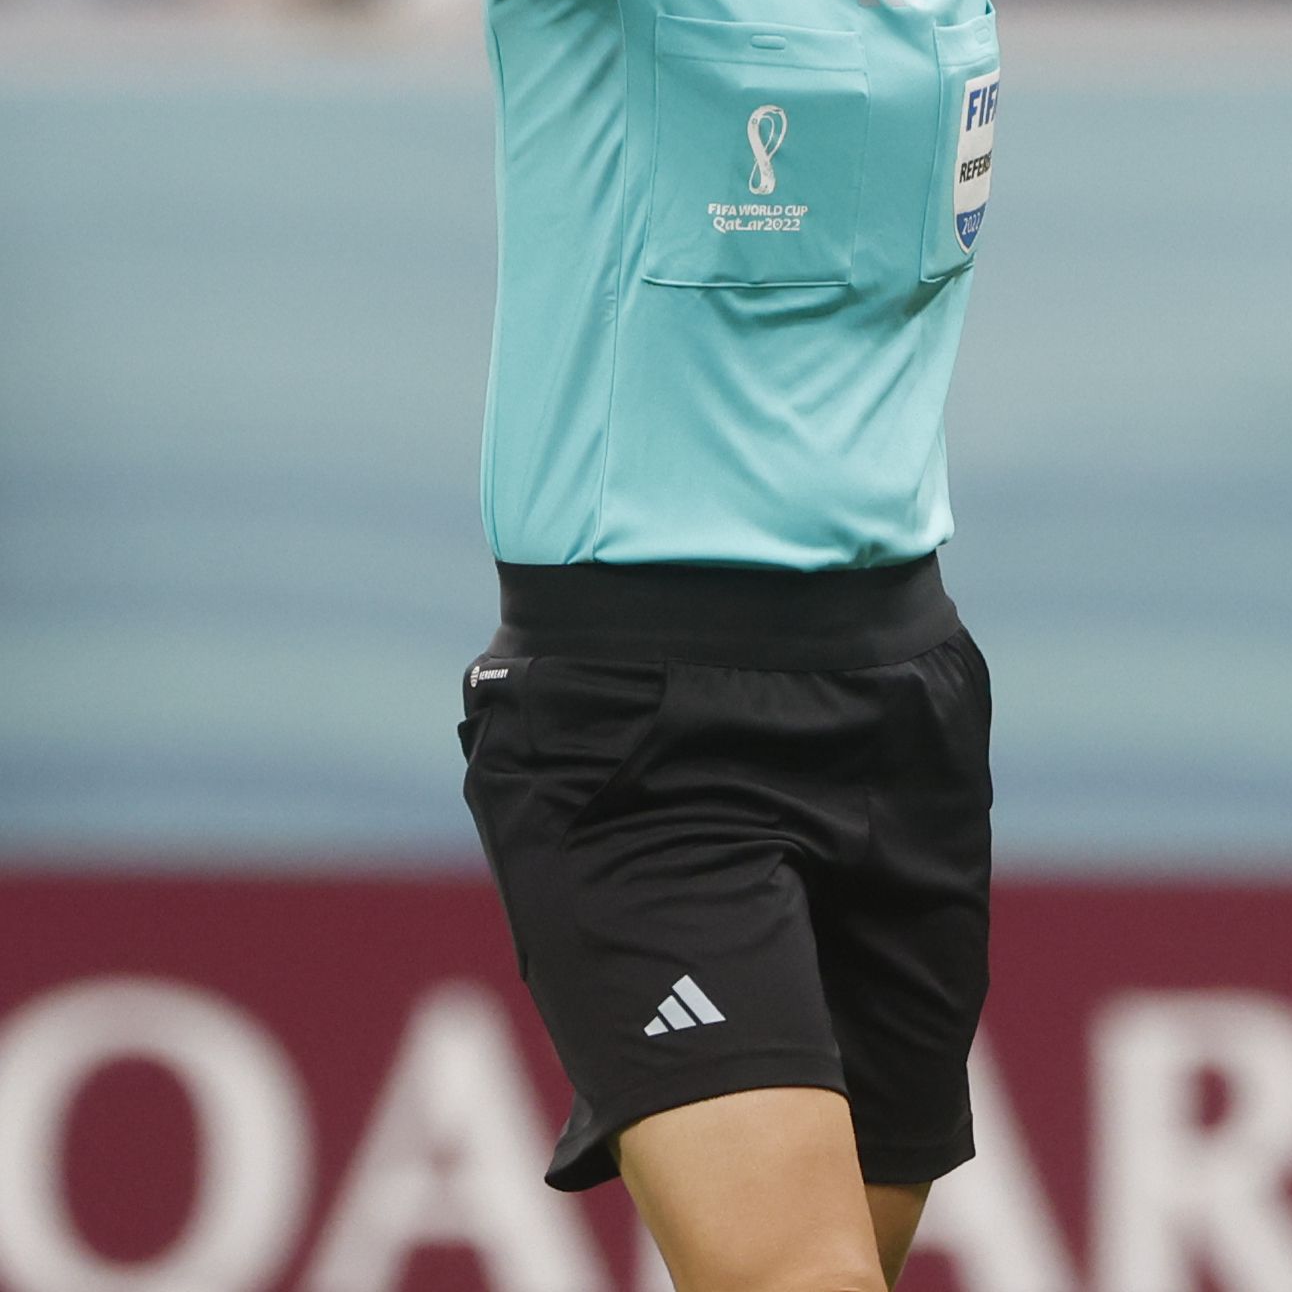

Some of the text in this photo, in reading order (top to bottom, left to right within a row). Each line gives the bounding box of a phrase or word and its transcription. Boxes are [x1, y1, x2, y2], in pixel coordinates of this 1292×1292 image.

[707, 203, 809, 217] FIFA WORLD CUP
